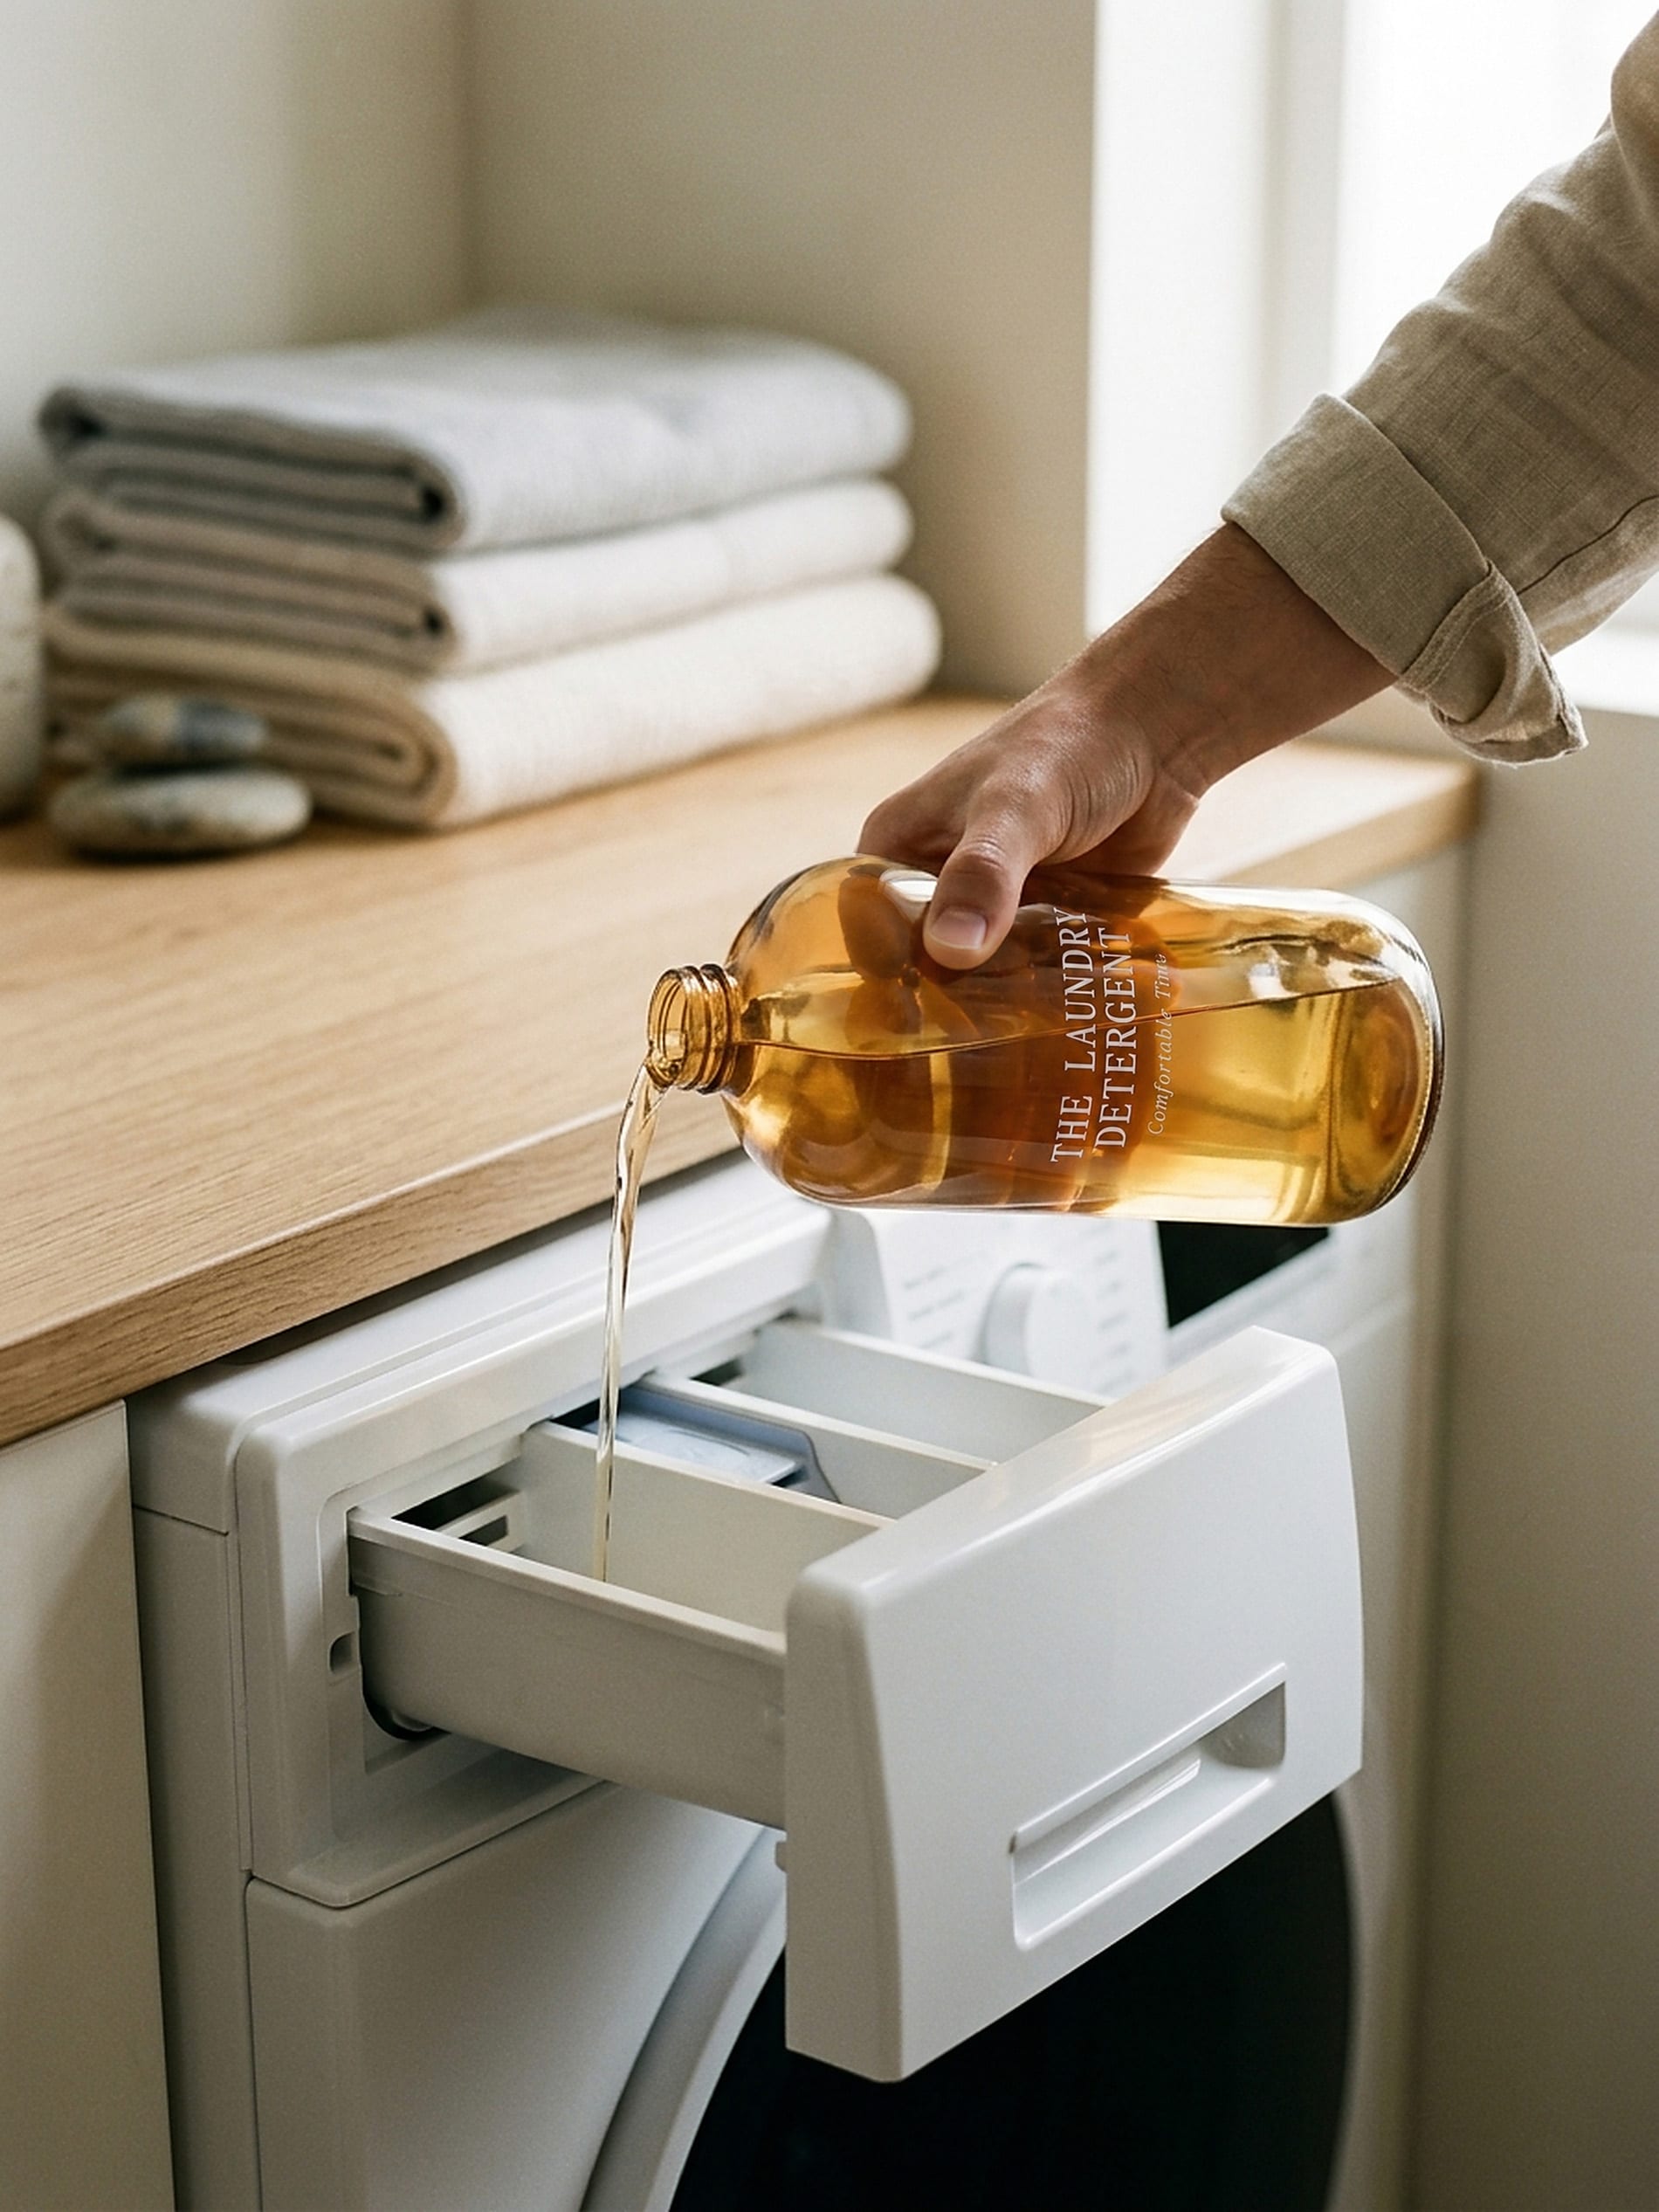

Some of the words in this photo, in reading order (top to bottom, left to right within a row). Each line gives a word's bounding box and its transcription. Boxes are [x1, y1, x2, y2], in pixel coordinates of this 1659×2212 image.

[1054, 907, 1097, 1072] LAUNDRY
[1094, 927, 1137, 1147] DETERGENT
[1050, 1095, 1092, 1162] THE
[1147, 1009, 1174, 1134] Comfortable
